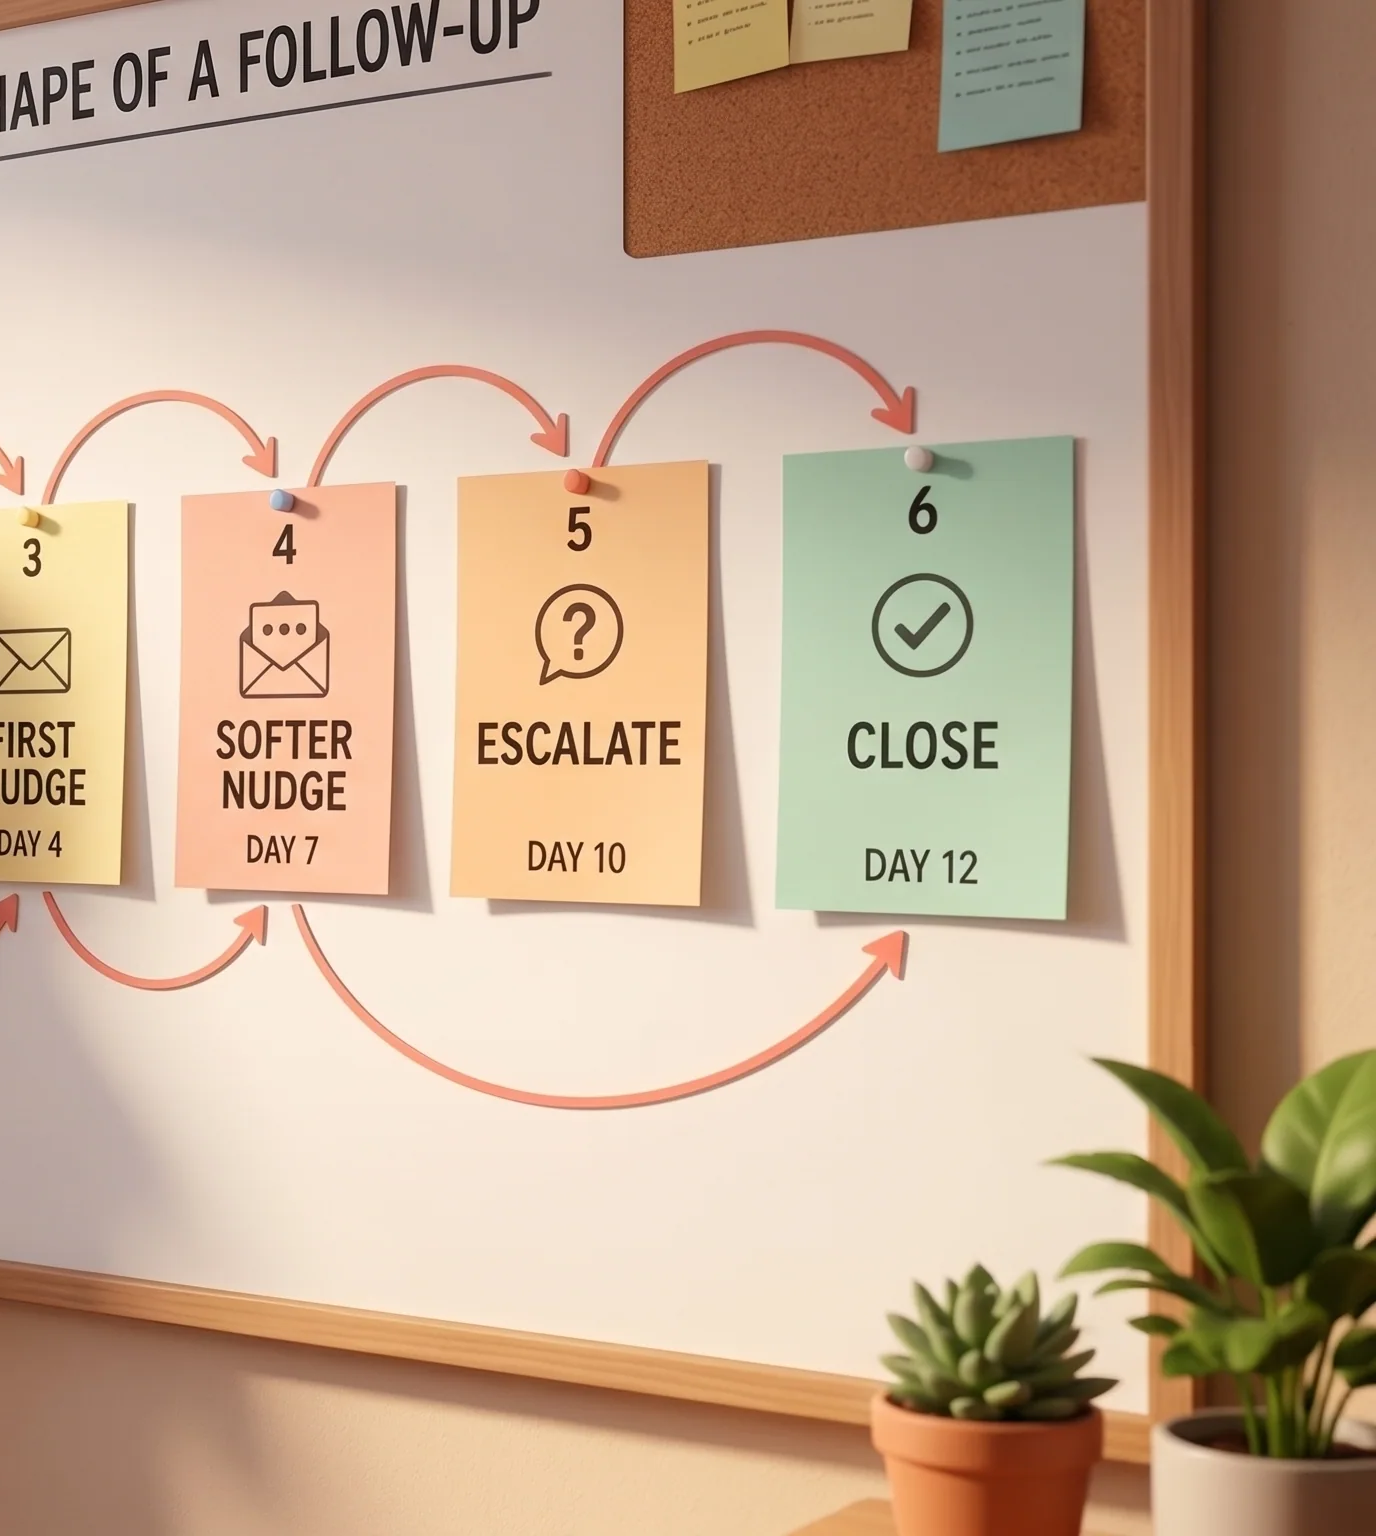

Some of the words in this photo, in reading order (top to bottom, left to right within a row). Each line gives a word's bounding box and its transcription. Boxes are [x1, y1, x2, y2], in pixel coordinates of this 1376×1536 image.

[112, 45, 171, 113] OF
[187, 38, 220, 102] A
[239, 0, 541, 94] FOLLOW-UP
[566, 505, 593, 552] 5
[908, 484, 938, 535] 6
[22, 537, 42, 578] 3
[271, 523, 297, 565] 4
[215, 719, 353, 760] SOFTER
[477, 720, 682, 766] ESCALATE
[846, 720, 999, 771] CLOSE
[222, 770, 347, 812] NUDGE
[47, 830, 63, 858] 4
[246, 834, 297, 865] DAY
[304, 835, 320, 866] 7
[527, 839, 585, 873] DAY
[593, 841, 627, 874] 10
[865, 847, 931, 883] DAY
[941, 849, 979, 885] 12
